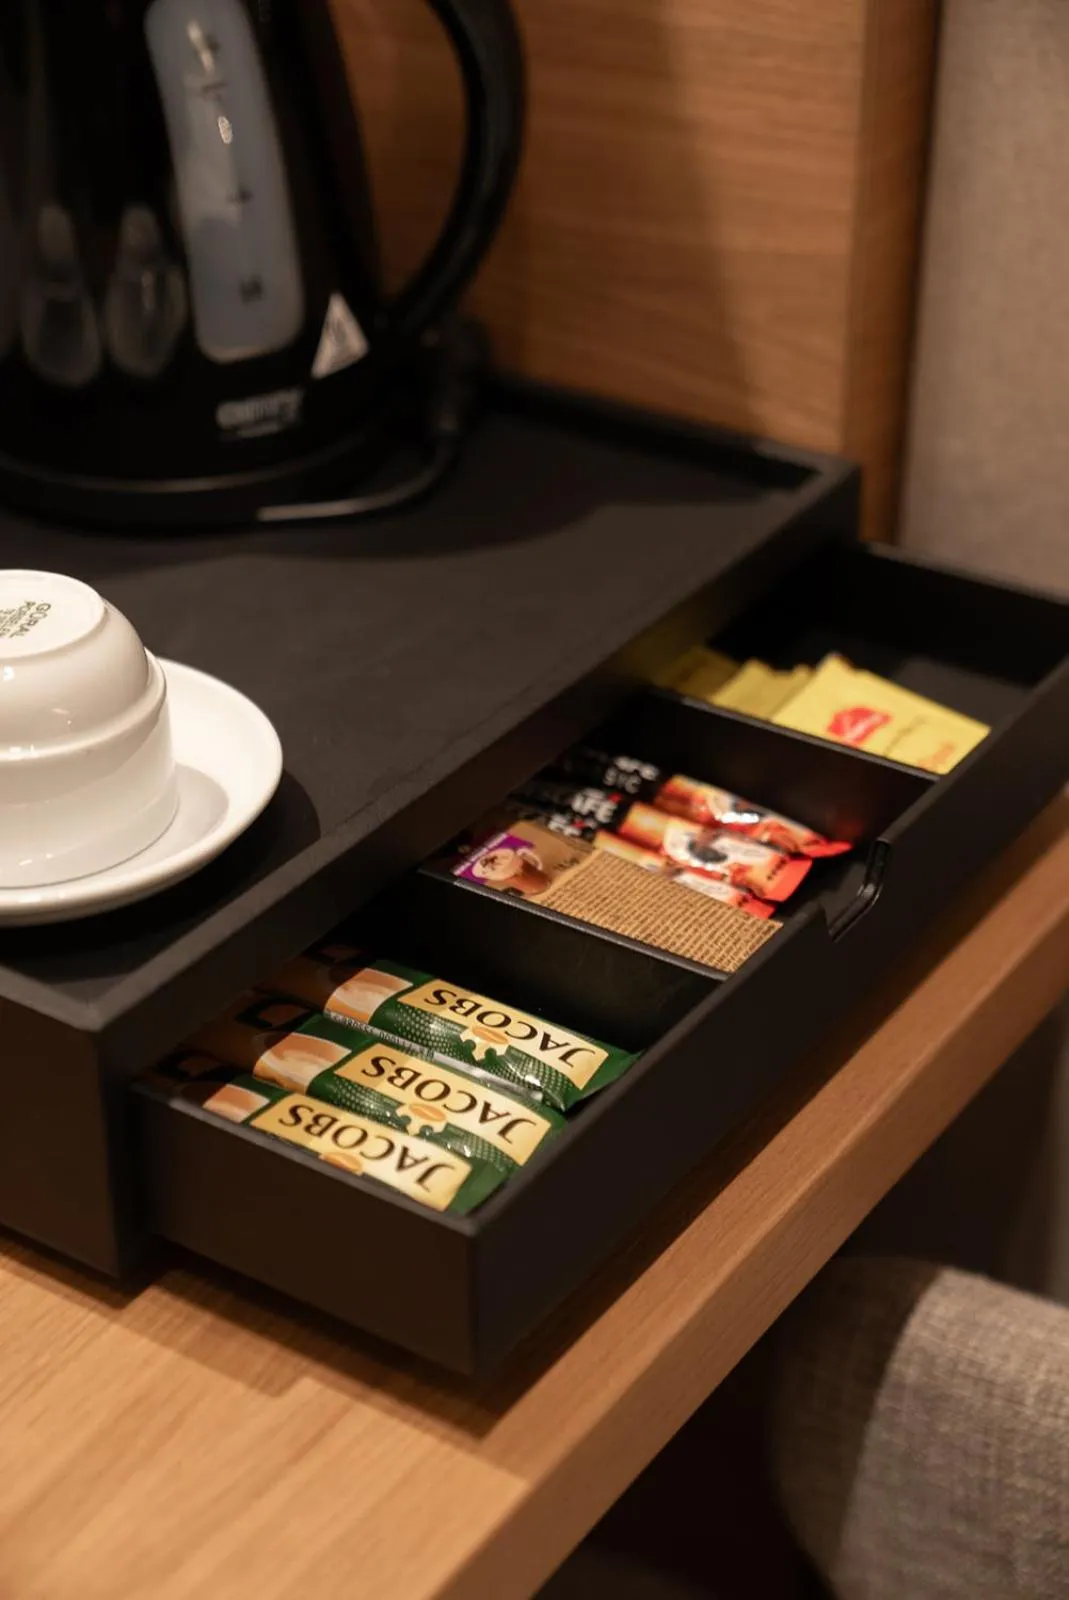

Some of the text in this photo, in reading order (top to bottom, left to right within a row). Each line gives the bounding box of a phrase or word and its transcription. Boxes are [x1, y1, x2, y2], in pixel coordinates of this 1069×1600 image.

[422, 987, 595, 1069] JACOBS
[361, 1055, 537, 1144] JACOBS
[278, 1102, 456, 1193] JACOBS
